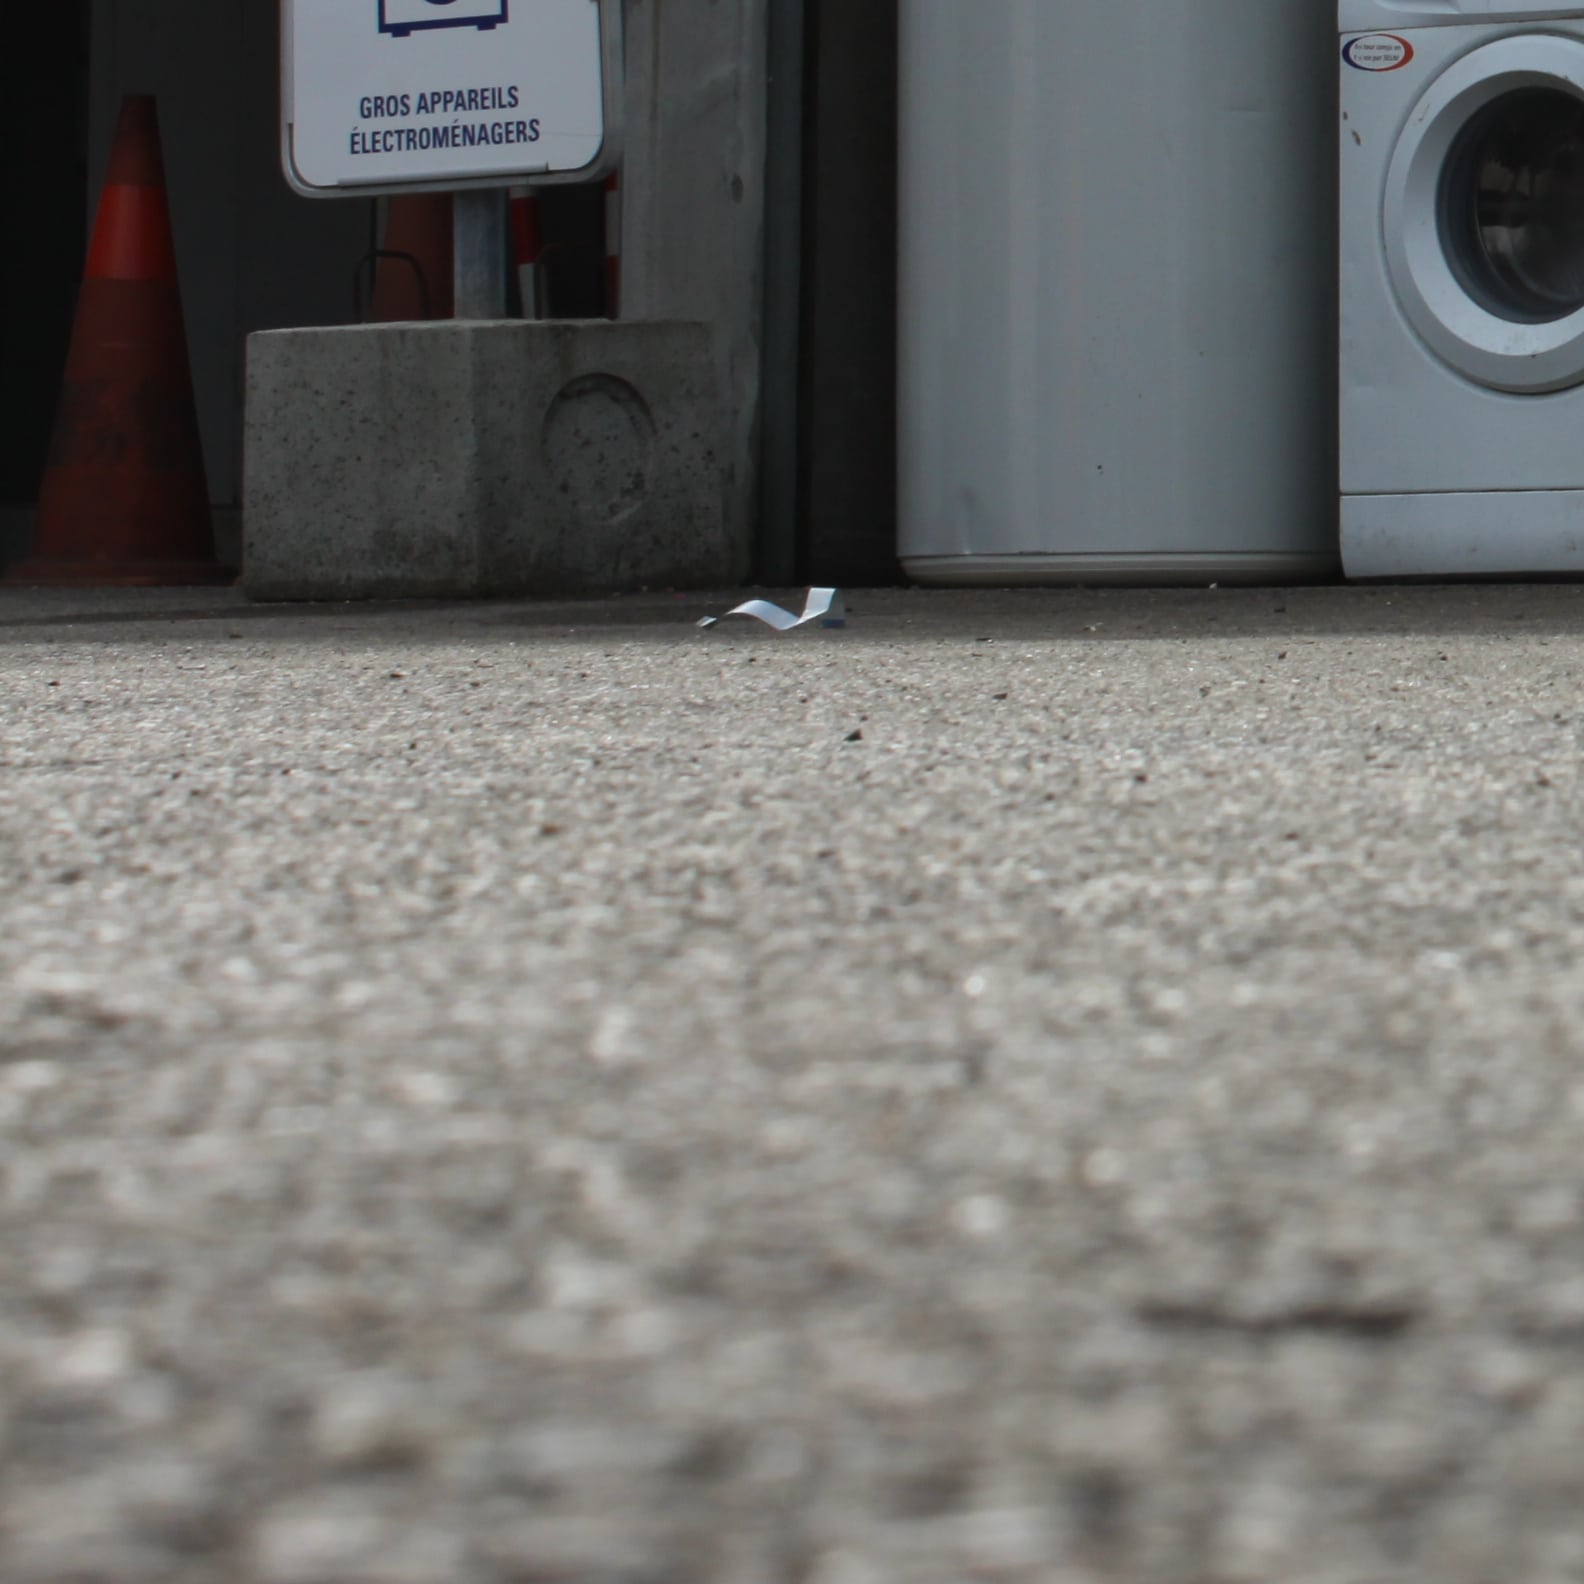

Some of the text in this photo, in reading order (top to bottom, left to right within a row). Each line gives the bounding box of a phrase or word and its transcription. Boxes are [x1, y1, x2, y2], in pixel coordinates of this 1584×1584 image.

[360, 86, 519, 119] GROS APPAREILS
[350, 119, 540, 155] ÉLECTROMÉNAGERS
